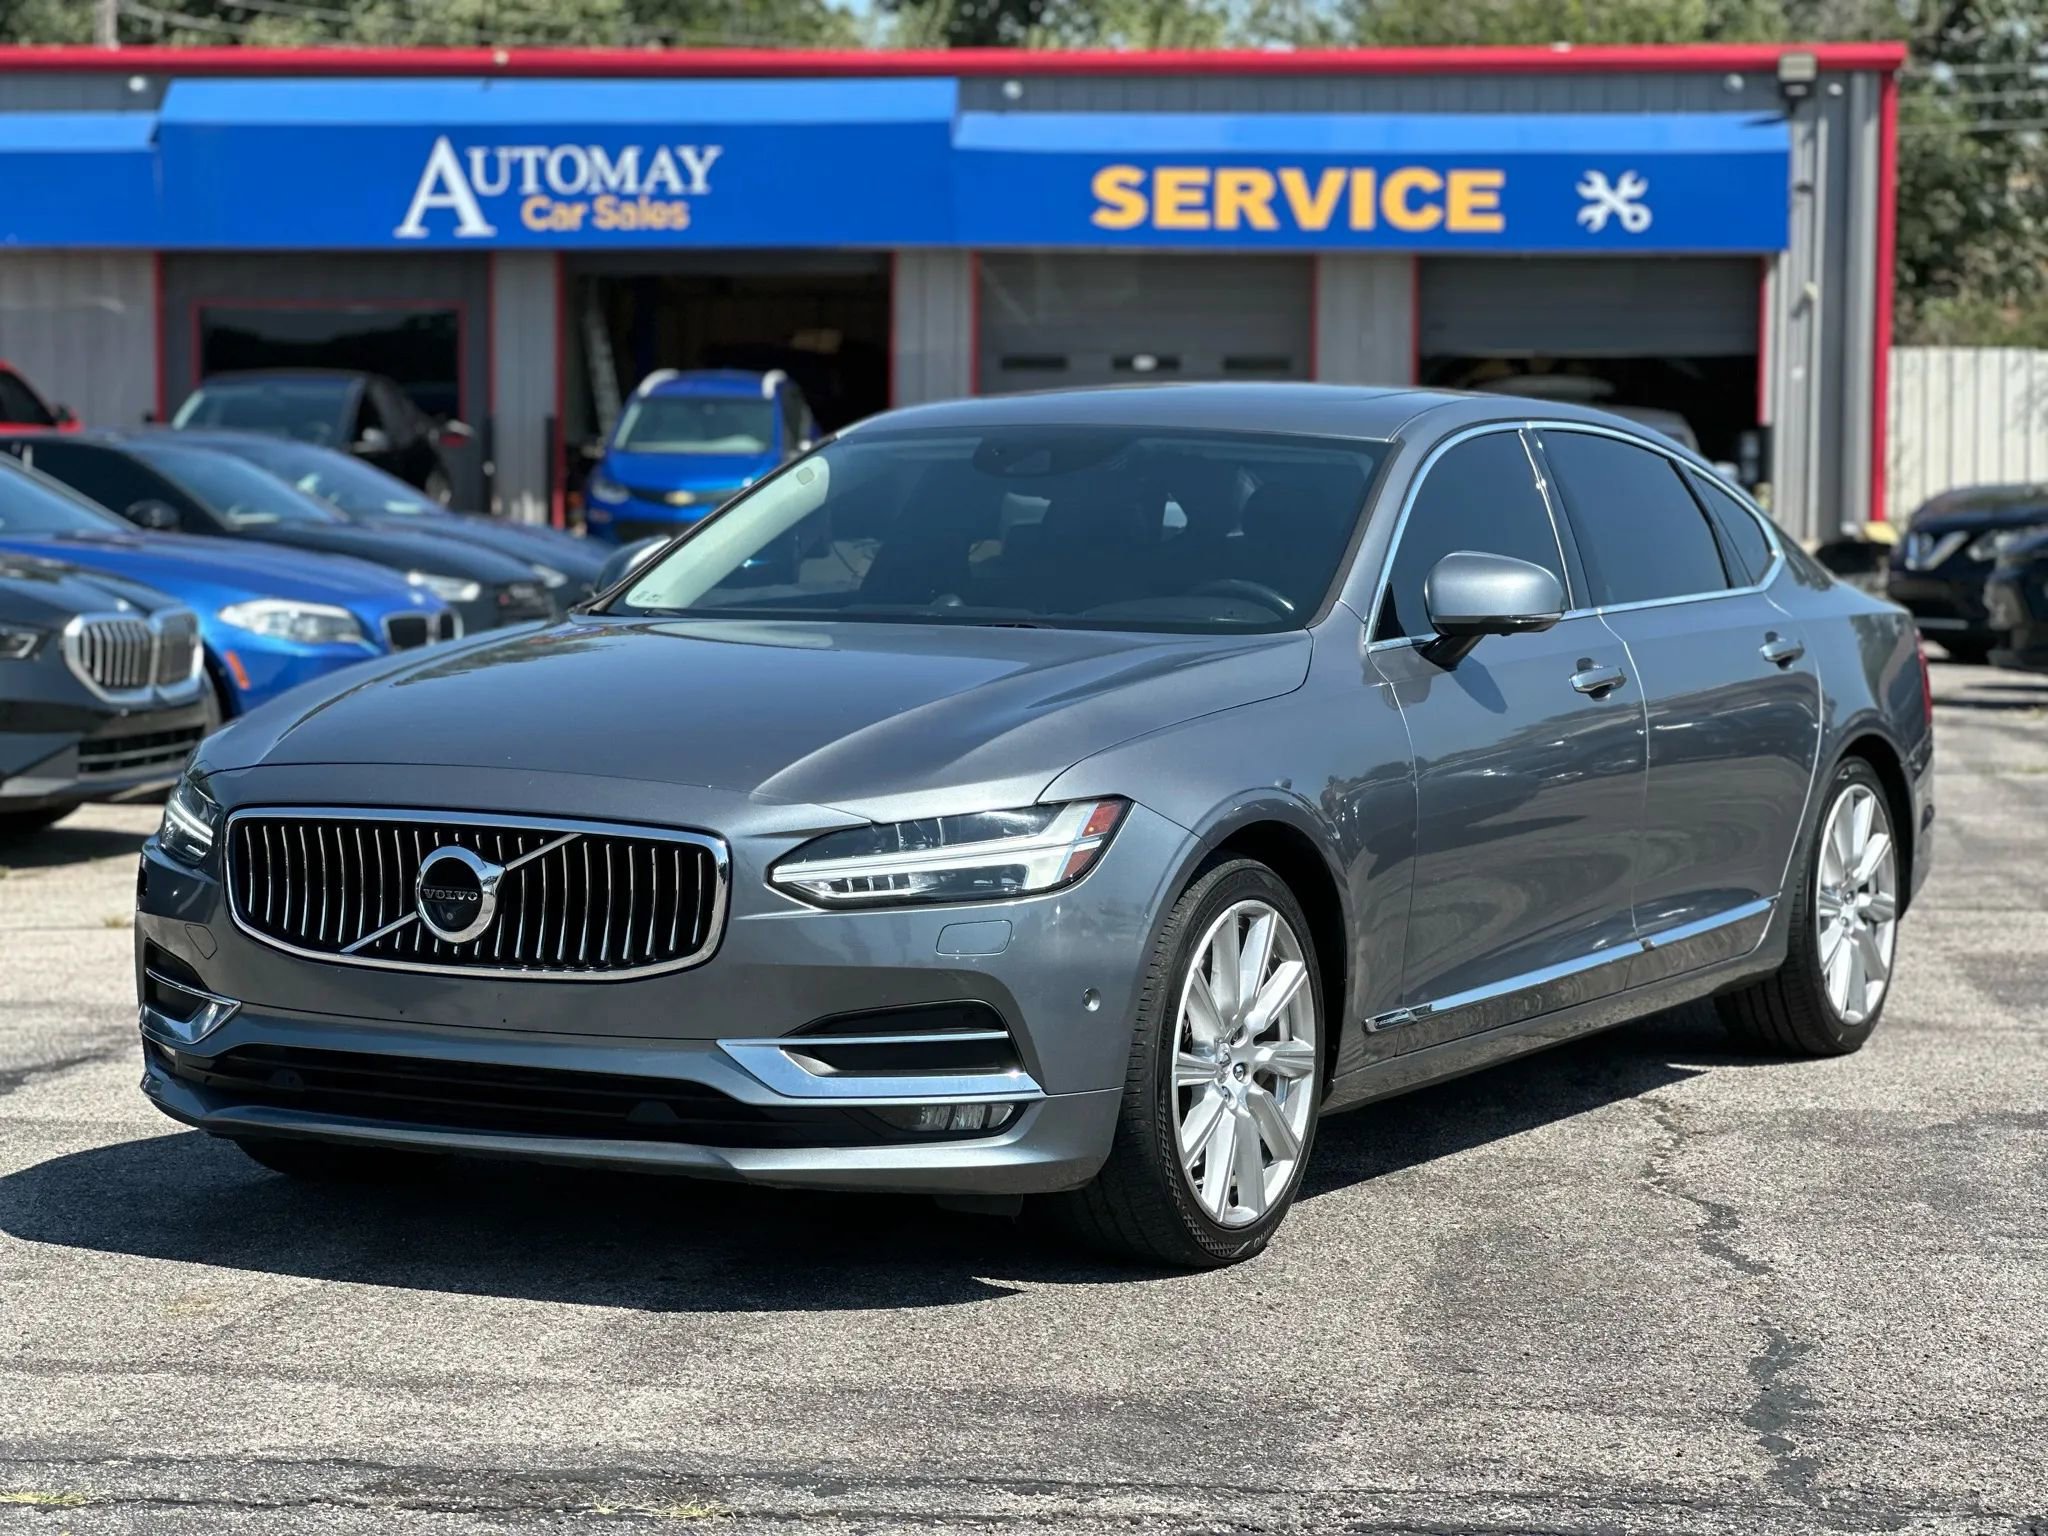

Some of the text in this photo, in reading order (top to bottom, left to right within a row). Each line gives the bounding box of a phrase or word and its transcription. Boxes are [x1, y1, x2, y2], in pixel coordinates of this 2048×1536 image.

[394, 134, 723, 239] AUTOMAY
[520, 194, 691, 231] Car Sales
[1091, 165, 1506, 233] SERVICE
[423, 888, 478, 901] VOLVO
